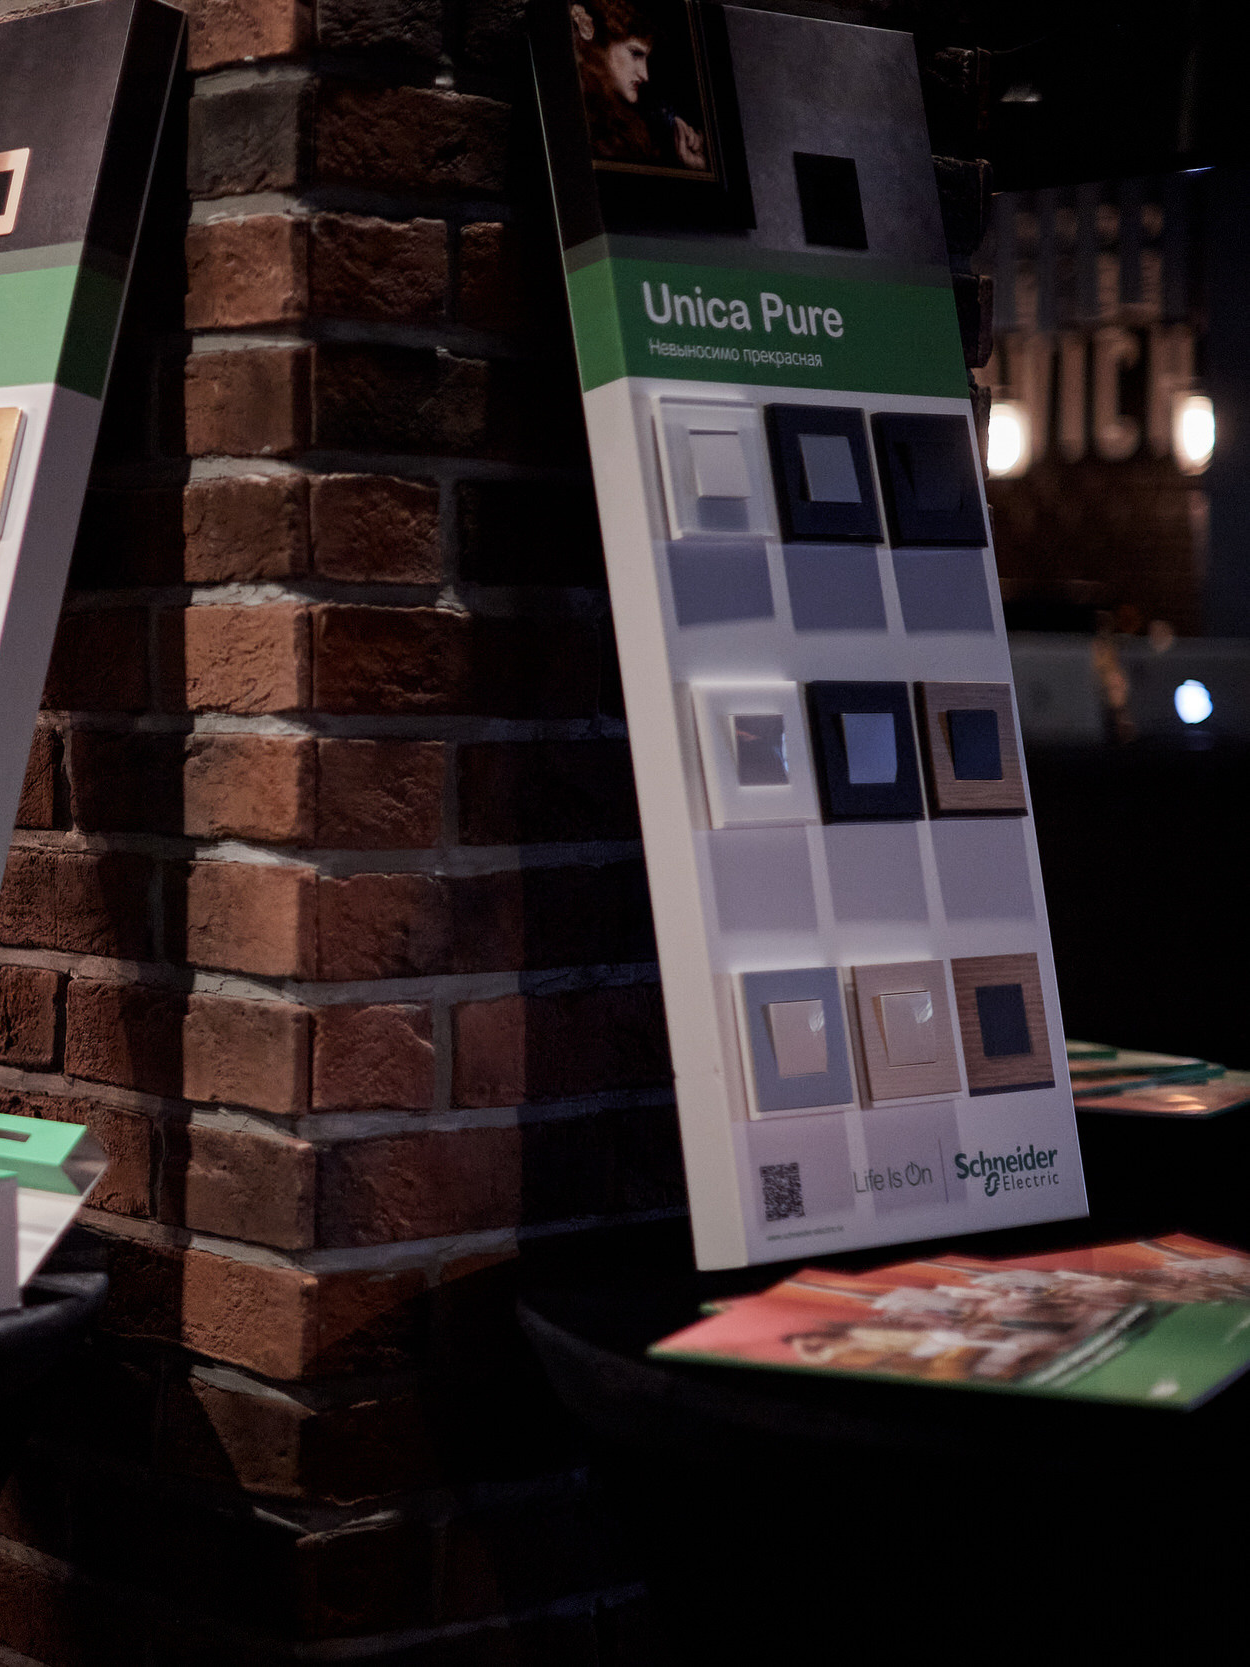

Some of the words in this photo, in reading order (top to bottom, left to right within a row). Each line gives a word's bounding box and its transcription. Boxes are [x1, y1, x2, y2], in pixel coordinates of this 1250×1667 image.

[642, 280, 752, 331] Unica
[760, 292, 844, 338] Pure
[649, 338, 740, 362] Невыносимо
[742, 346, 823, 368] прекрасная
[853, 1168, 884, 1194] Life
[886, 1166, 903, 1189] Is
[905, 1161, 933, 1187] On
[954, 1144, 1058, 1180] Schneider
[1003, 1171, 1060, 1192] Electric
